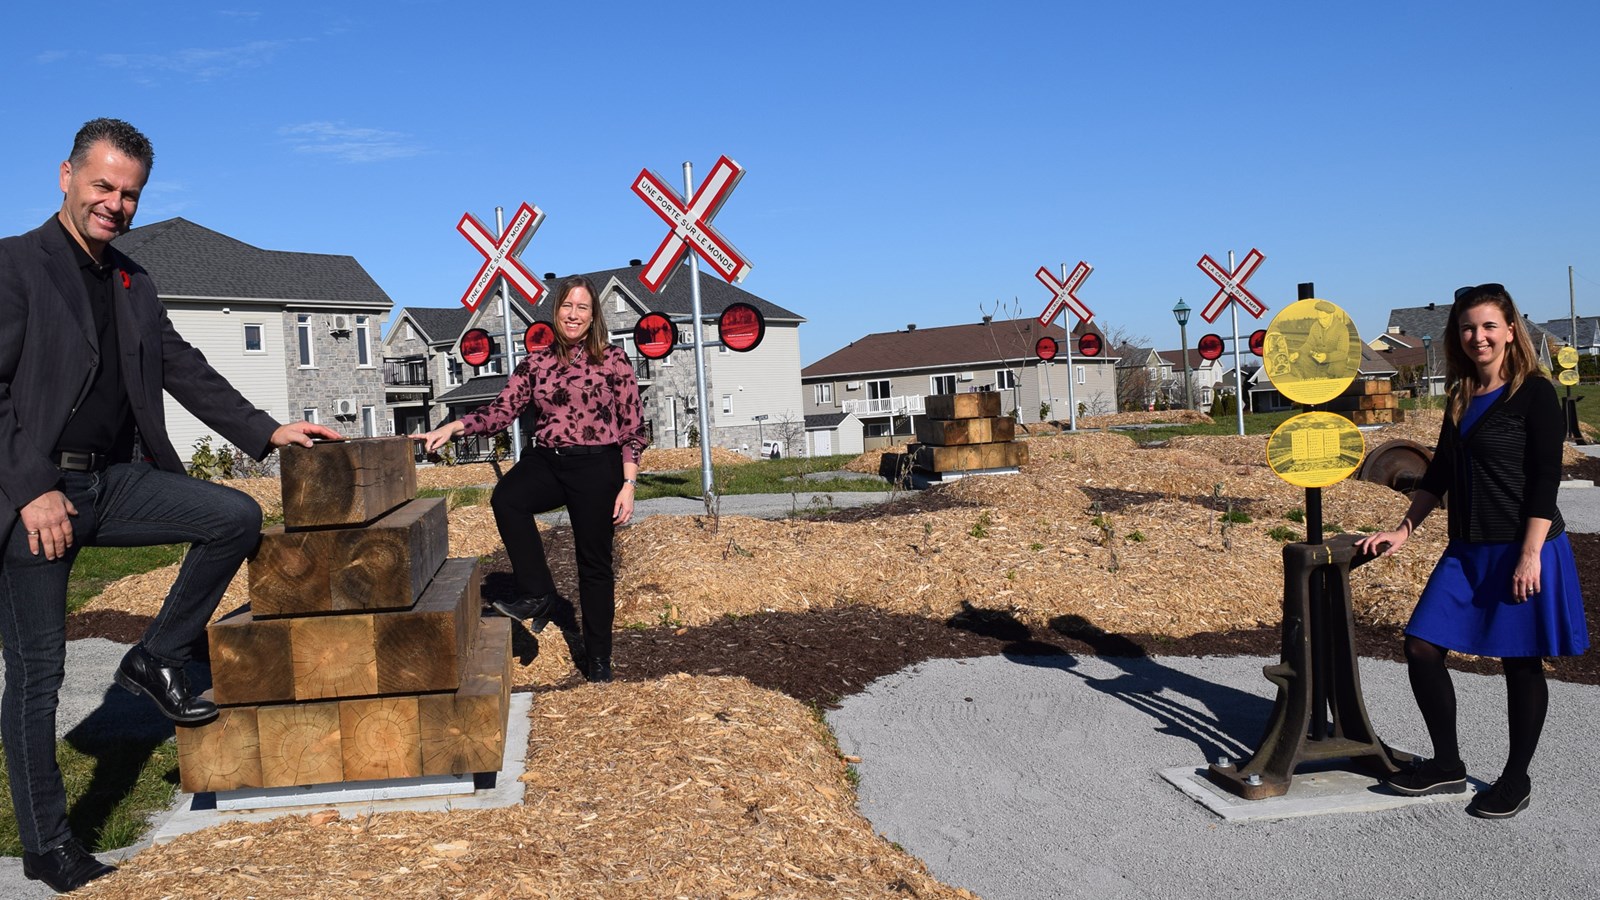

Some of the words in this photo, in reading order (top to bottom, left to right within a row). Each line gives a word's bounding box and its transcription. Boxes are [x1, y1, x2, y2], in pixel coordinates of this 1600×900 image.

[641, 181, 656, 198] UNE
[656, 196, 681, 220] PORTE
[680, 218, 697, 236] SUR
[696, 234, 708, 246] LE
[707, 244, 734, 271] MONDE
[468, 286, 480, 302] UNE
[479, 264, 496, 287] PORTE
[494, 249, 506, 264] SUR
[504, 238, 512, 248] LE
[511, 212, 529, 238] MONDE
[1071, 268, 1083, 283] TEMPS
[1235, 289, 1243, 297] DU
[1244, 297, 1260, 312] TEMPS
